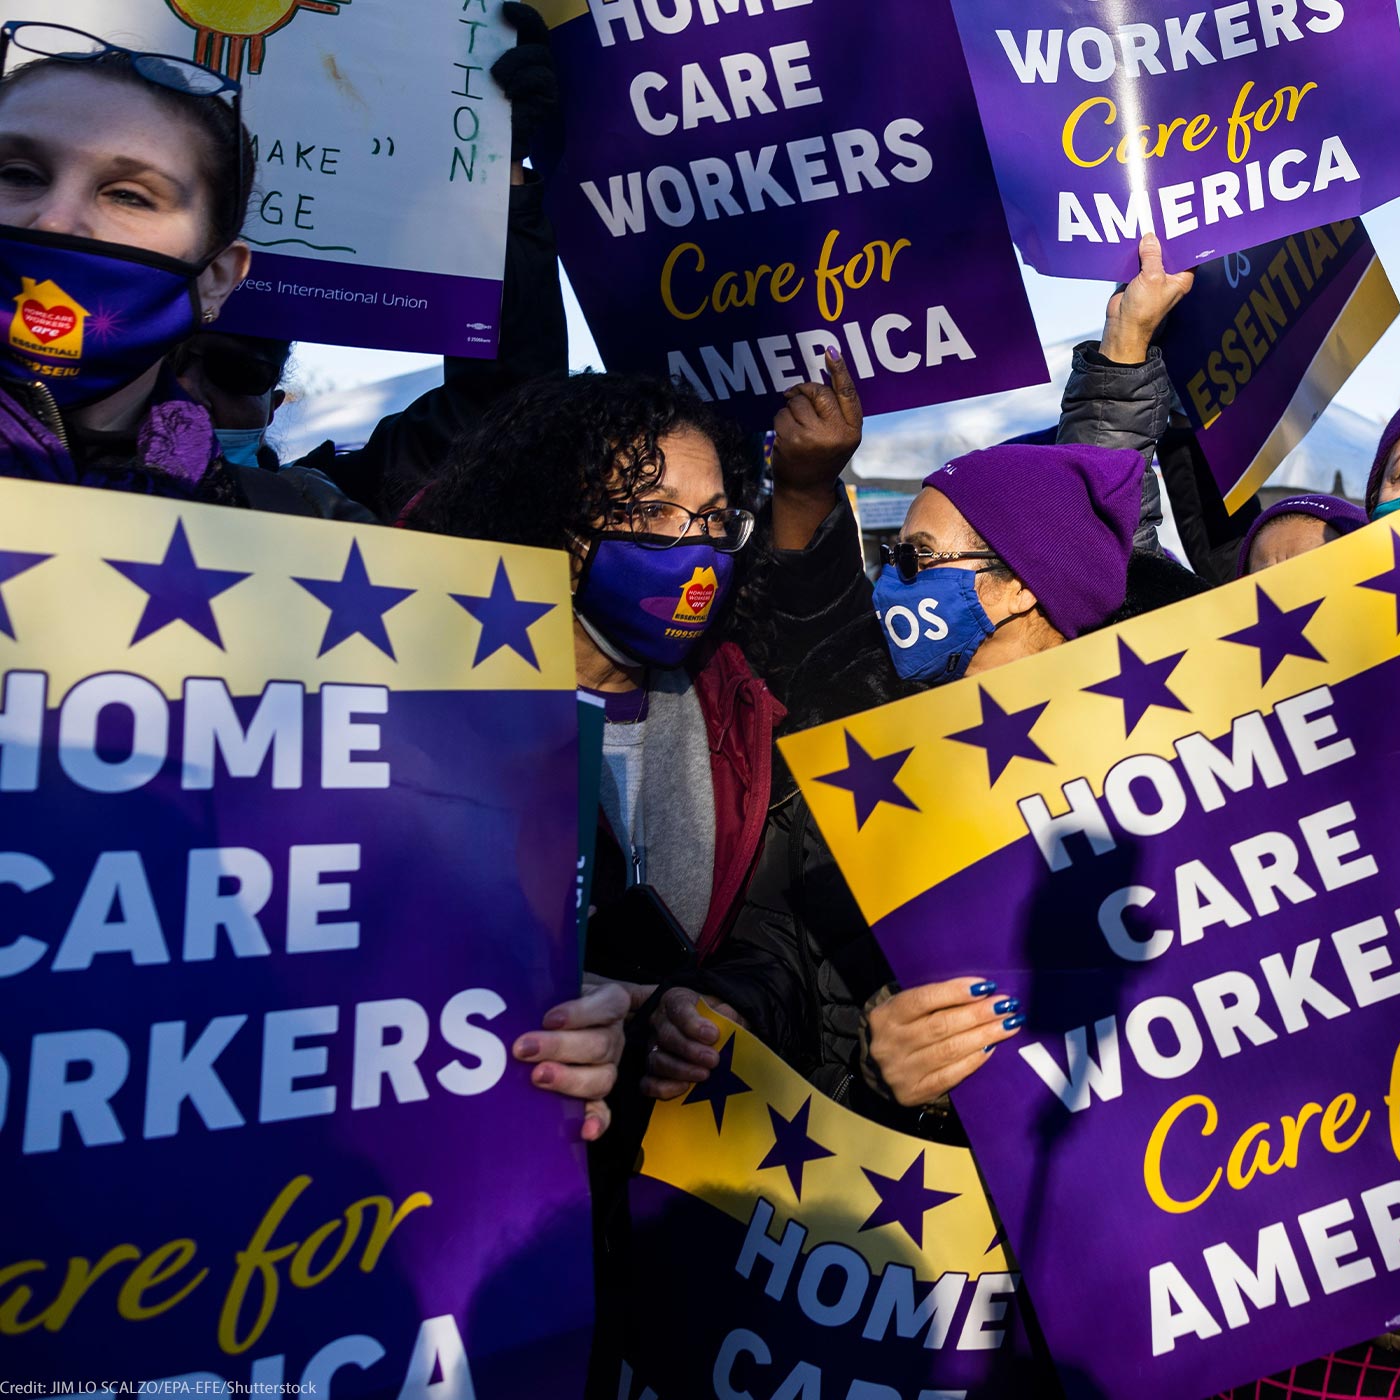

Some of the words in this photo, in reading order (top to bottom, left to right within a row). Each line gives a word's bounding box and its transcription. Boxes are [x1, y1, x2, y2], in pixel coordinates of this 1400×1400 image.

[628, 40, 824, 137] CARE
[994, 0, 1345, 84] WORKERS
[1061, 96, 1218, 168] Care
[1226, 80, 1318, 164] for
[580, 117, 934, 238] WORKERS
[1057, 135, 1361, 244] AMERICA
[277, 280, 378, 305] International
[382, 292, 428, 310] Union
[660, 242, 804, 320] Care
[814, 229, 911, 322] for
[31, 325, 60, 337] are
[665, 304, 976, 403] AMERICA
[876, 598, 950, 649] OS
[1018, 686, 1356, 873] HOME
[1097, 800, 1379, 962] CARE
[0, 987, 508, 1155] RKERS
[1143, 1093, 1371, 1215] Care
[217, 1174, 433, 1355] for
[734, 1198, 1020, 1352] HOME
